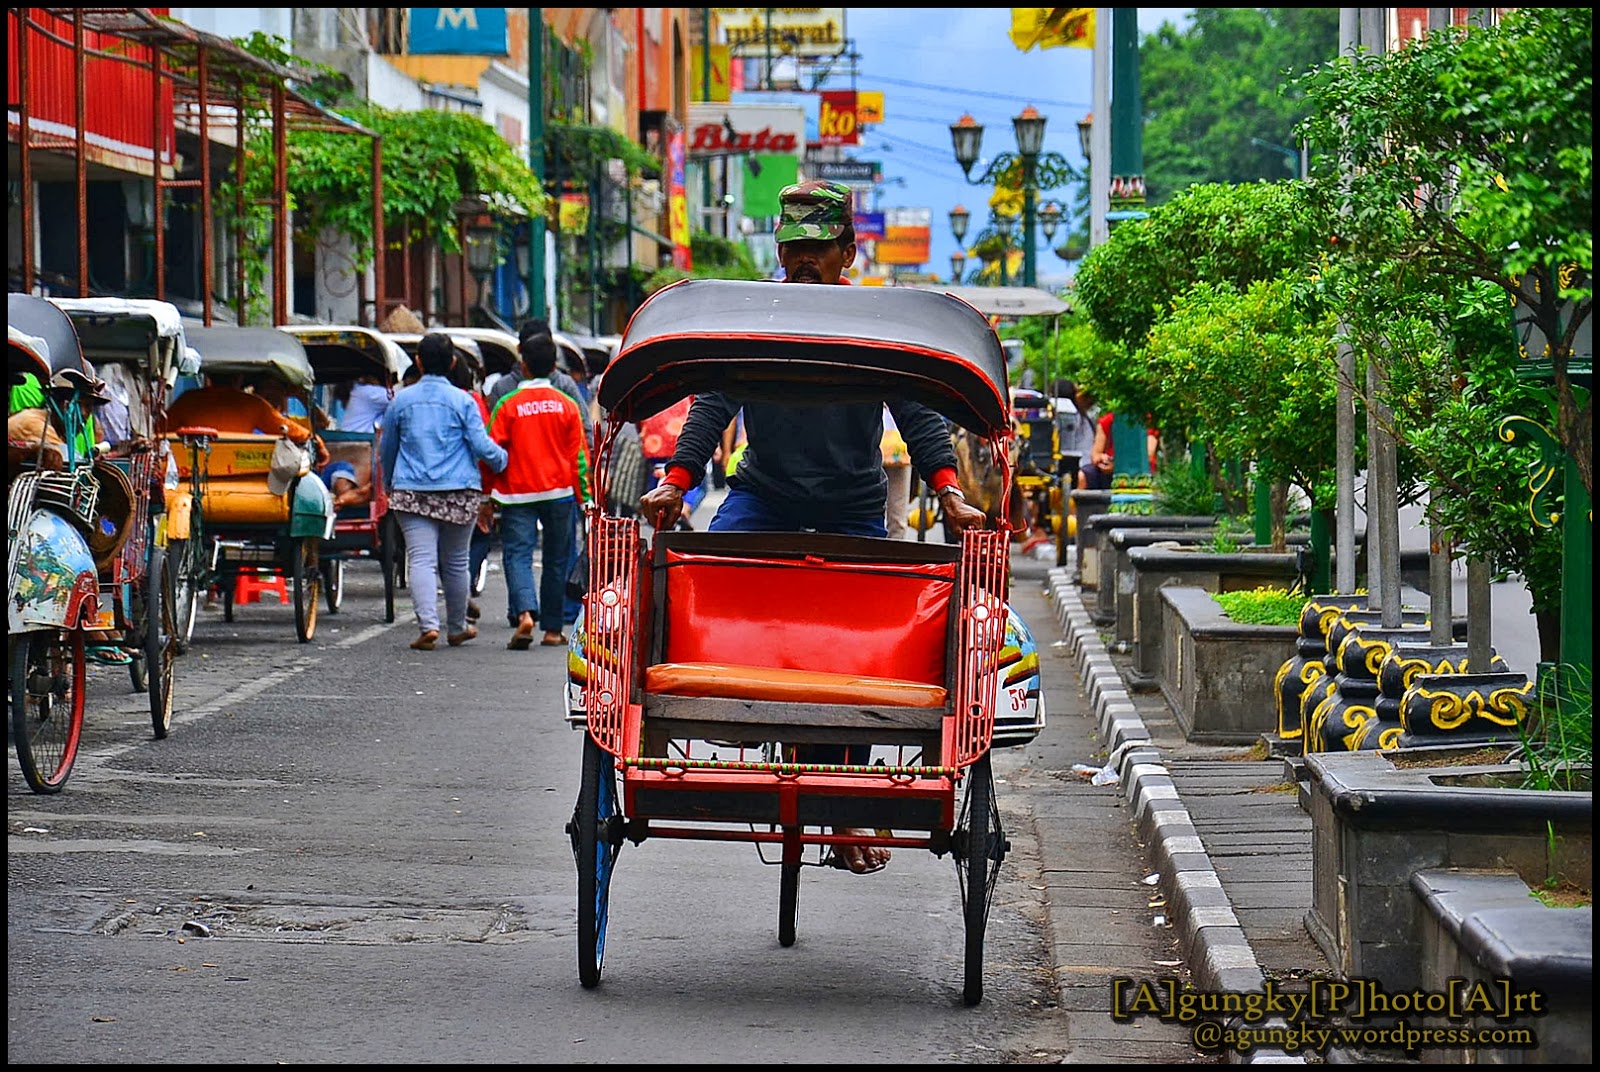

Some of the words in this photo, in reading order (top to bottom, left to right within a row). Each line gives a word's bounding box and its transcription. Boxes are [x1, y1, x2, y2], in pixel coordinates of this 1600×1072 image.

[820, 102, 856, 136] ko
[690, 122, 798, 153] Bata
[516, 399, 564, 418] INDONESIA
[1008, 688, 1028, 712] 59
